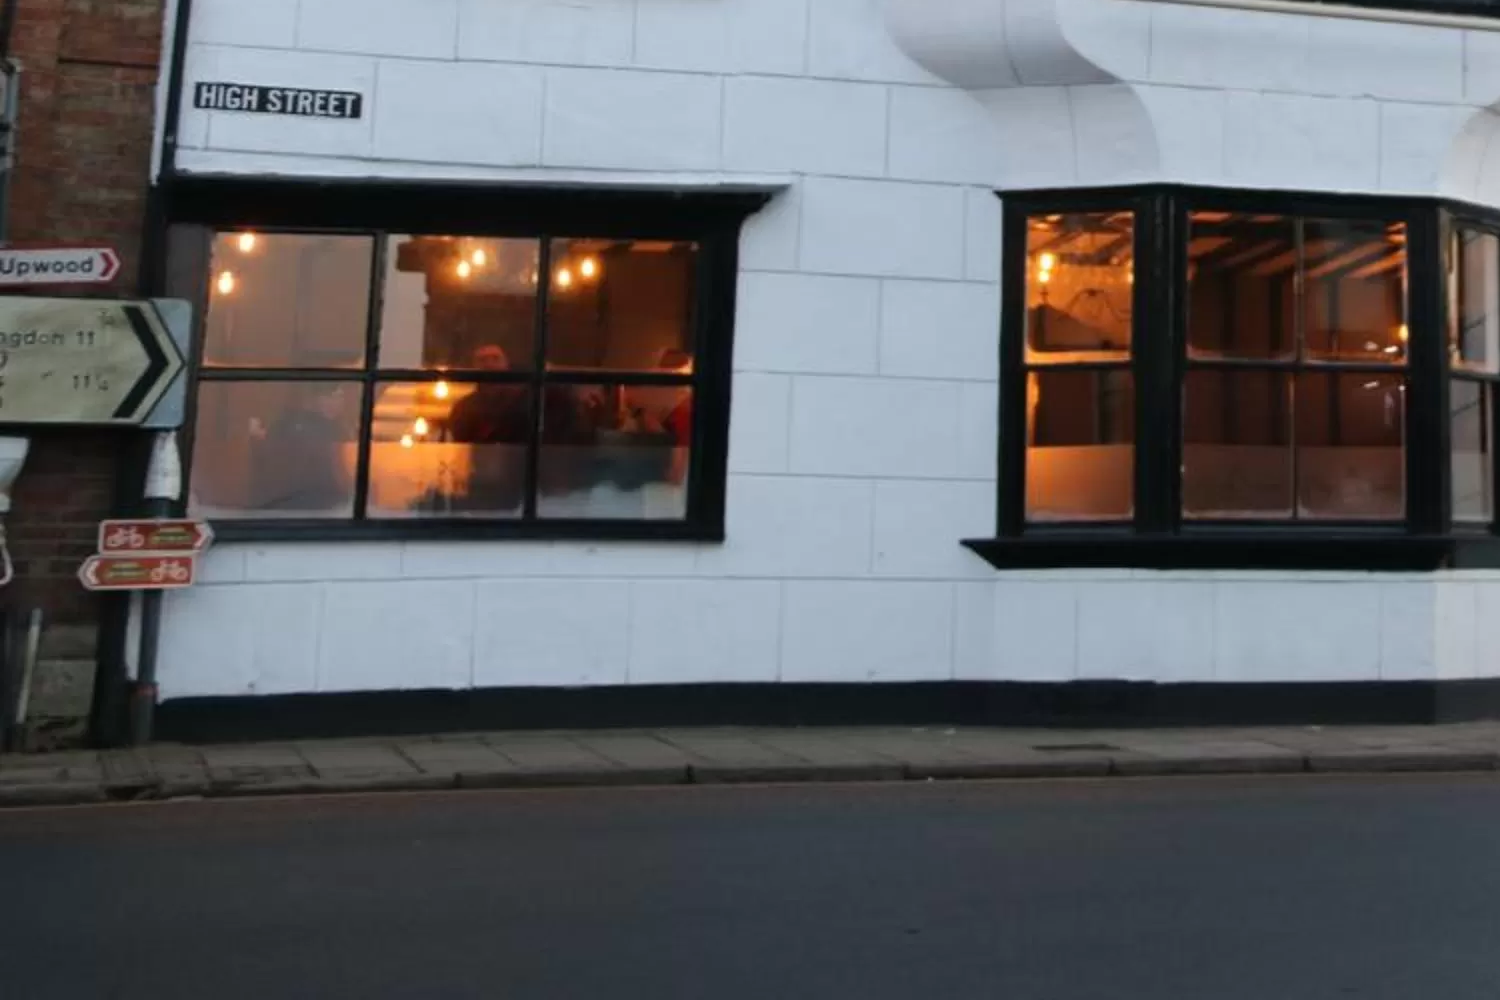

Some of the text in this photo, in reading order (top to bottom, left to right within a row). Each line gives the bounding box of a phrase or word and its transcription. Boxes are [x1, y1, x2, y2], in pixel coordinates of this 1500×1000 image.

[201, 85, 357, 118] HIGH STREET
[0, 256, 94, 277] Upwood
